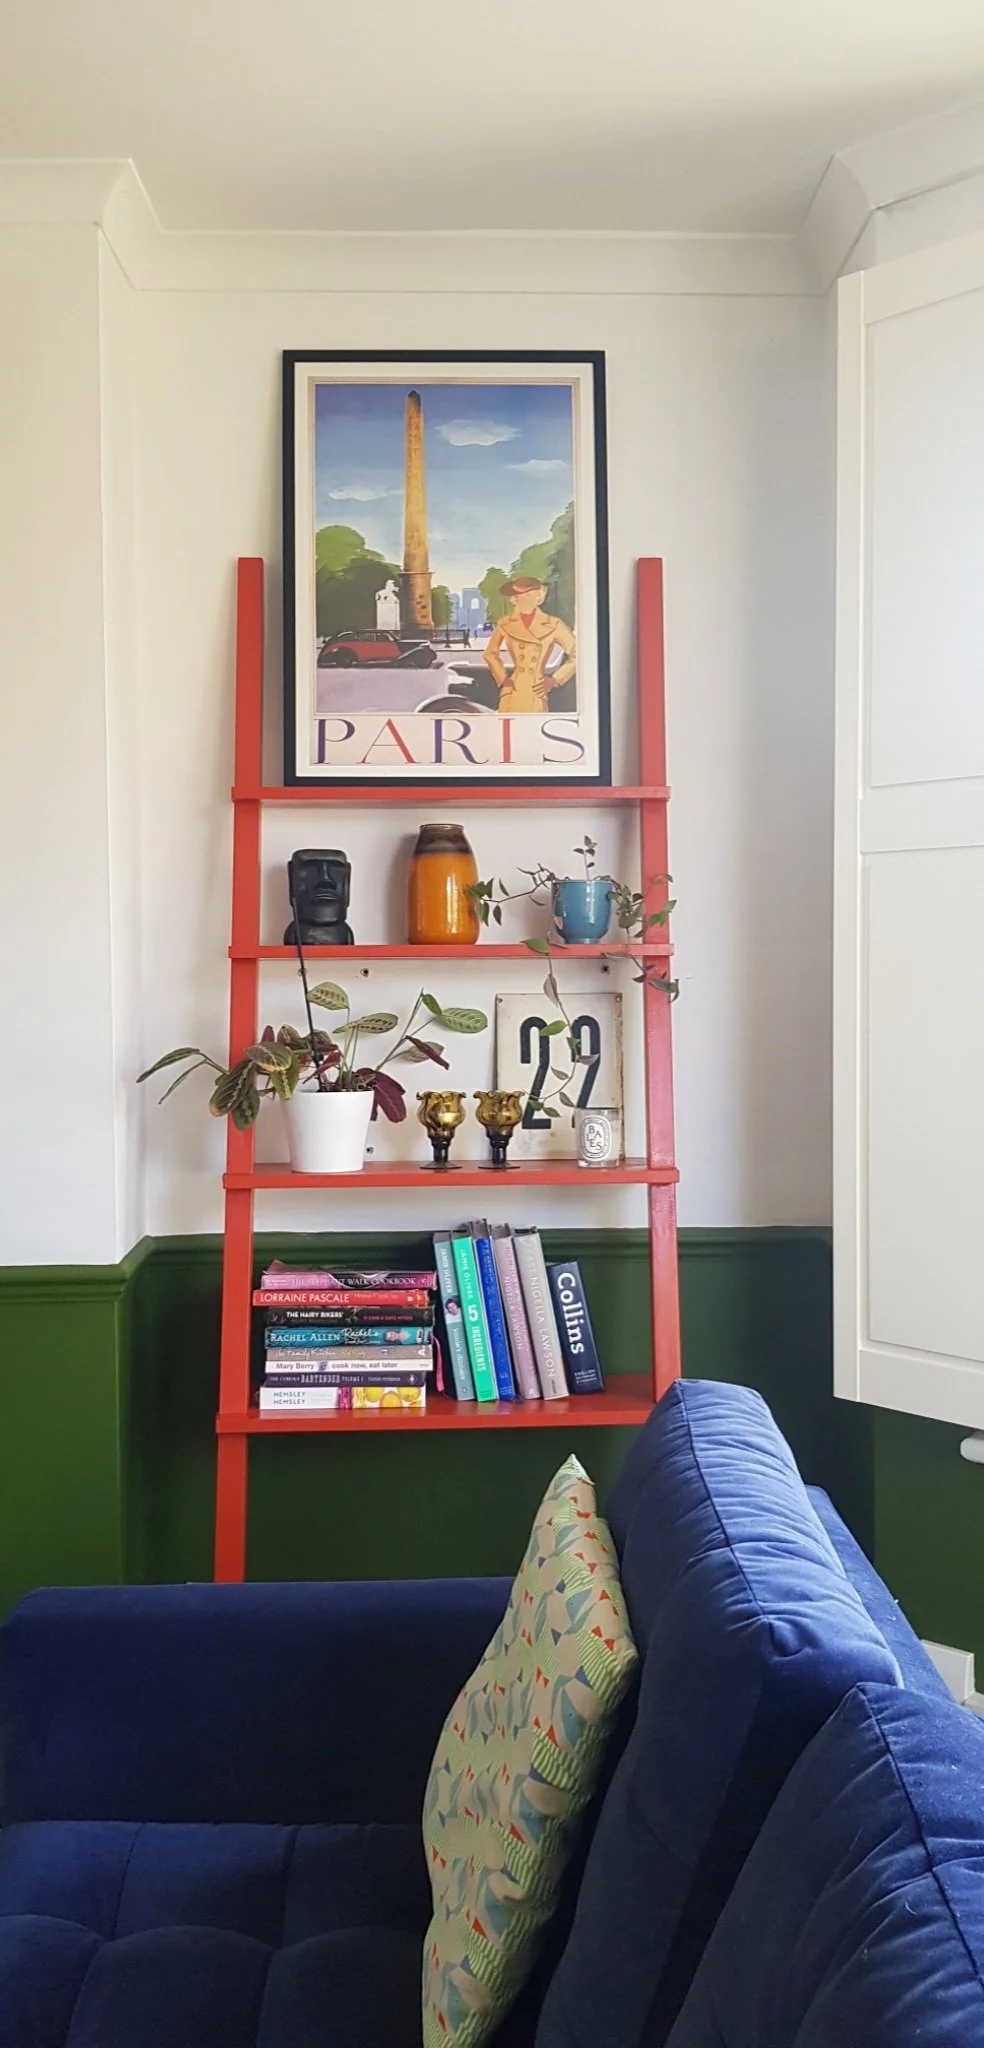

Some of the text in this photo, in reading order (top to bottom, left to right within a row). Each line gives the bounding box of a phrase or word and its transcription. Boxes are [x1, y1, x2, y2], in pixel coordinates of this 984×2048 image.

[313, 718, 585, 765] PARIS
[347, 1278, 369, 1286] WALK
[371, 1277, 416, 1286] COOKBOOK
[442, 1269, 452, 1292] OLIVER
[463, 1271, 474, 1299] OLIVER
[260, 1292, 350, 1303] LORRAINE PASCALE
[502, 1276, 515, 1310] NIGELLA
[509, 1313, 523, 1350] LAWSON
[558, 1272, 585, 1354] Collins
[270, 1333, 306, 1342] RACHEL
[309, 1332, 341, 1342] ALLEN
[341, 1327, 381, 1340] Rachel's
[467, 1304, 486, 1372] 5 INGREDIENTS
[529, 1275, 547, 1323] NIGELLA
[539, 1327, 556, 1377] LAWSON
[276, 1363, 295, 1371] Mary
[296, 1362, 315, 1371] Berry
[351, 1363, 367, 1371] now,
[382, 1361, 398, 1369] later
